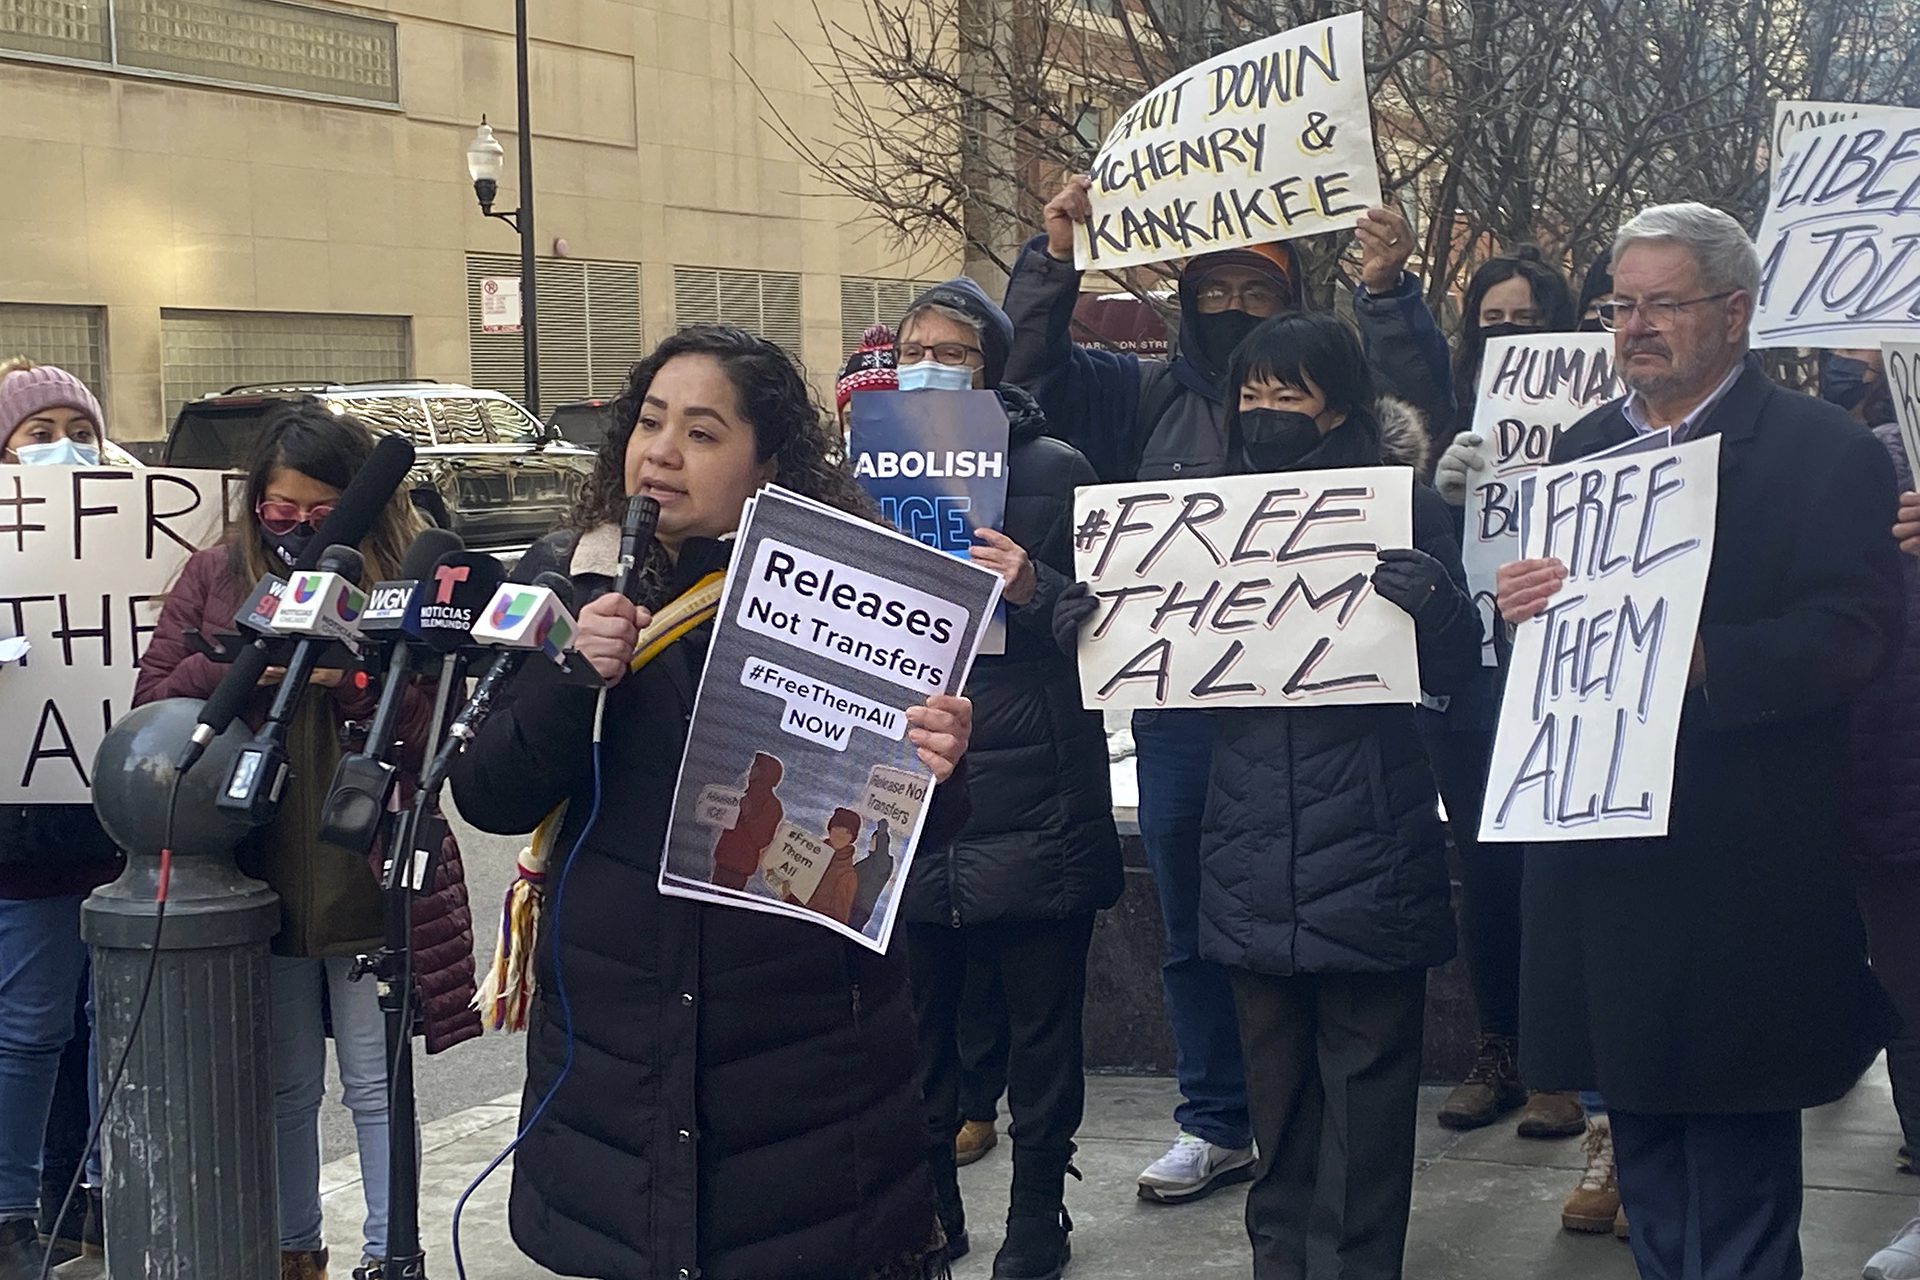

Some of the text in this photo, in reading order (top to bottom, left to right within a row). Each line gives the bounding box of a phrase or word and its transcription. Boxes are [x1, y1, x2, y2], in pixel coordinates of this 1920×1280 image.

[1208, 26, 1341, 117] DOWN
[1301, 111, 1337, 152] &
[1082, 171, 1371, 261] KANKAKEE
[852, 450, 1003, 479] ABOLISH
[1074, 486, 1384, 582] #FREE
[1541, 455, 1700, 583] FREE
[368, 587, 414, 610] WGN
[420, 606, 472, 621] NOTICIAS
[763, 549, 954, 645] Releases
[1092, 571, 1377, 639] THEM
[747, 596, 944, 687] Not Transfers
[1096, 636, 1390, 704] ALL
[1532, 593, 1668, 725] THEM
[748, 664, 896, 730] #FreeThemAll
[788, 709, 846, 742] NOW
[1493, 707, 1655, 830] ALL
